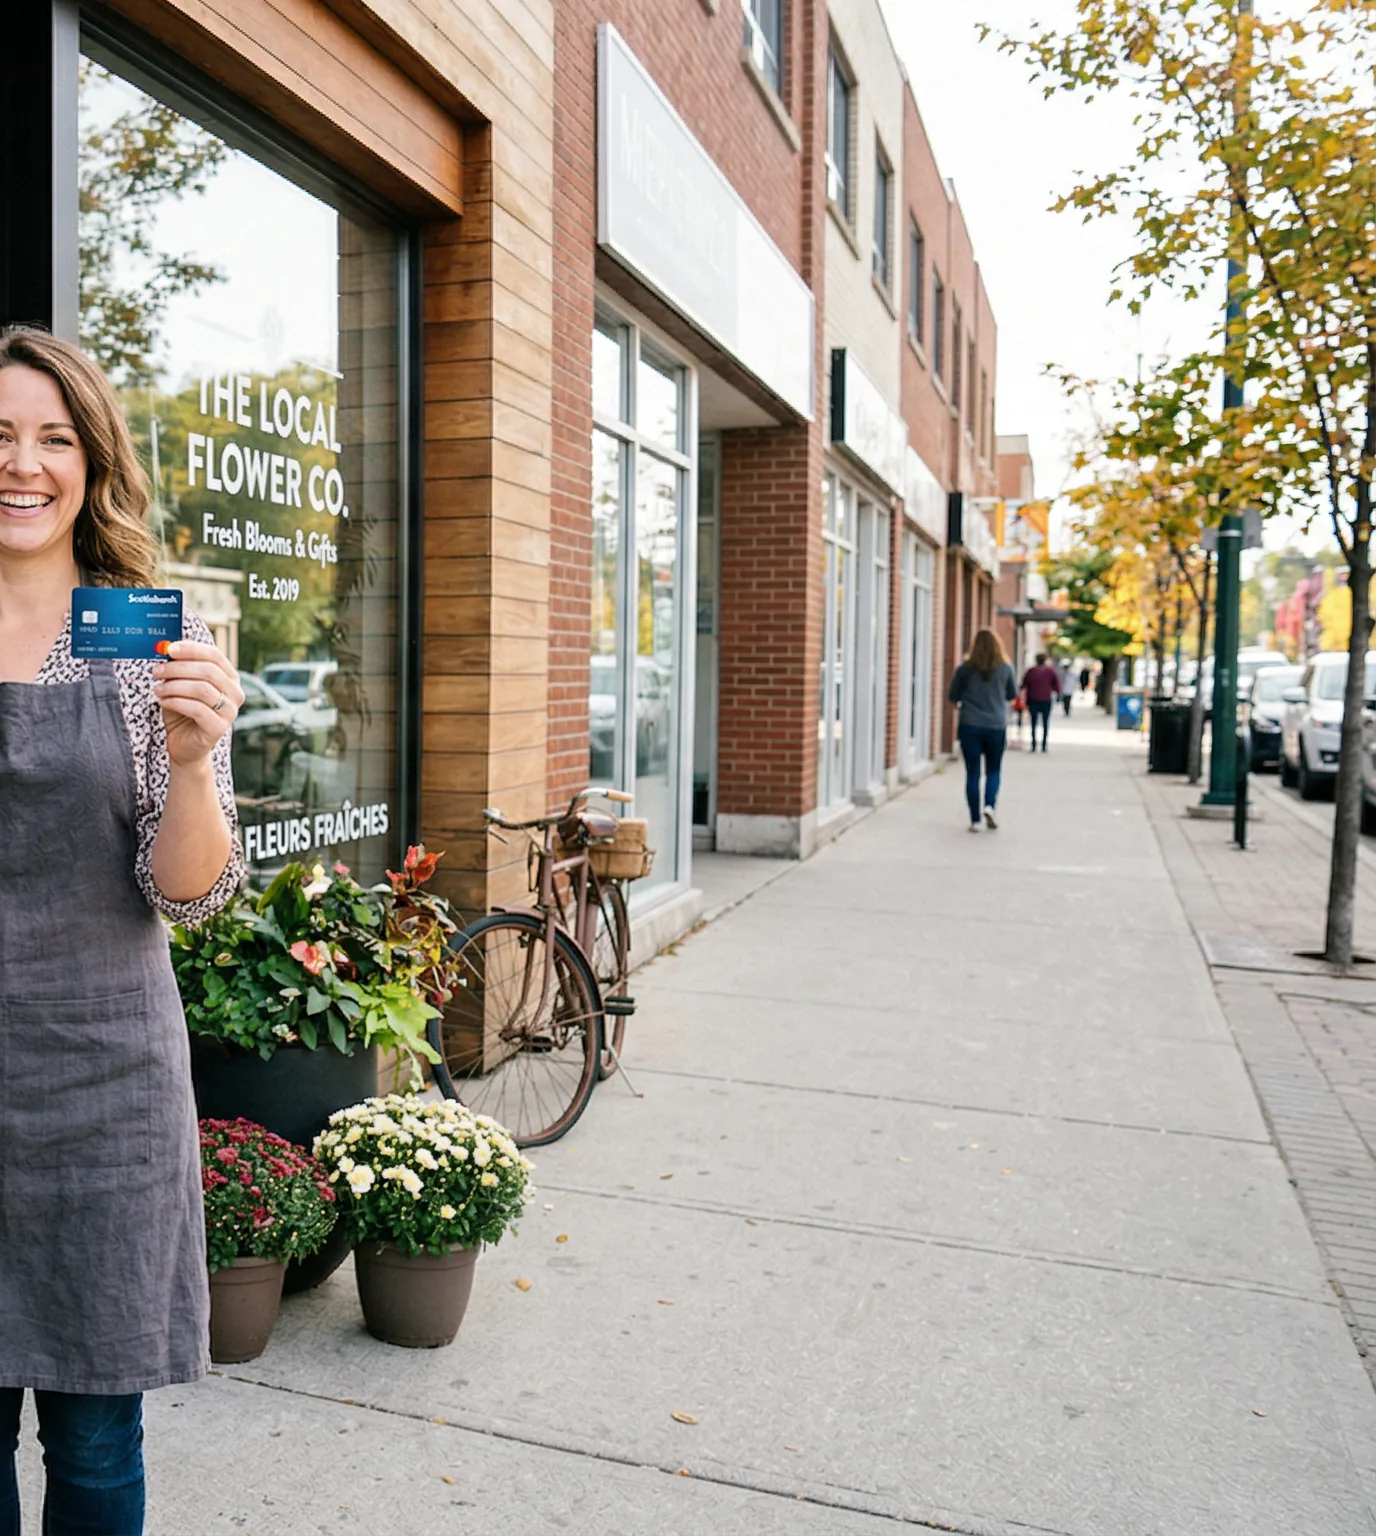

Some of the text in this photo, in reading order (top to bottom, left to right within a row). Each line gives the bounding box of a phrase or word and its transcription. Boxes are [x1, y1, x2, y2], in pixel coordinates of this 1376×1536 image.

[193, 363, 342, 454] THE LOCAL
[188, 431, 350, 518] FLOWER CO.
[202, 512, 338, 569] Fresh Blooms & Gifts
[248, 572, 300, 602] Est. 2019
[245, 799, 389, 863] FLEURS FRAÎCHES
